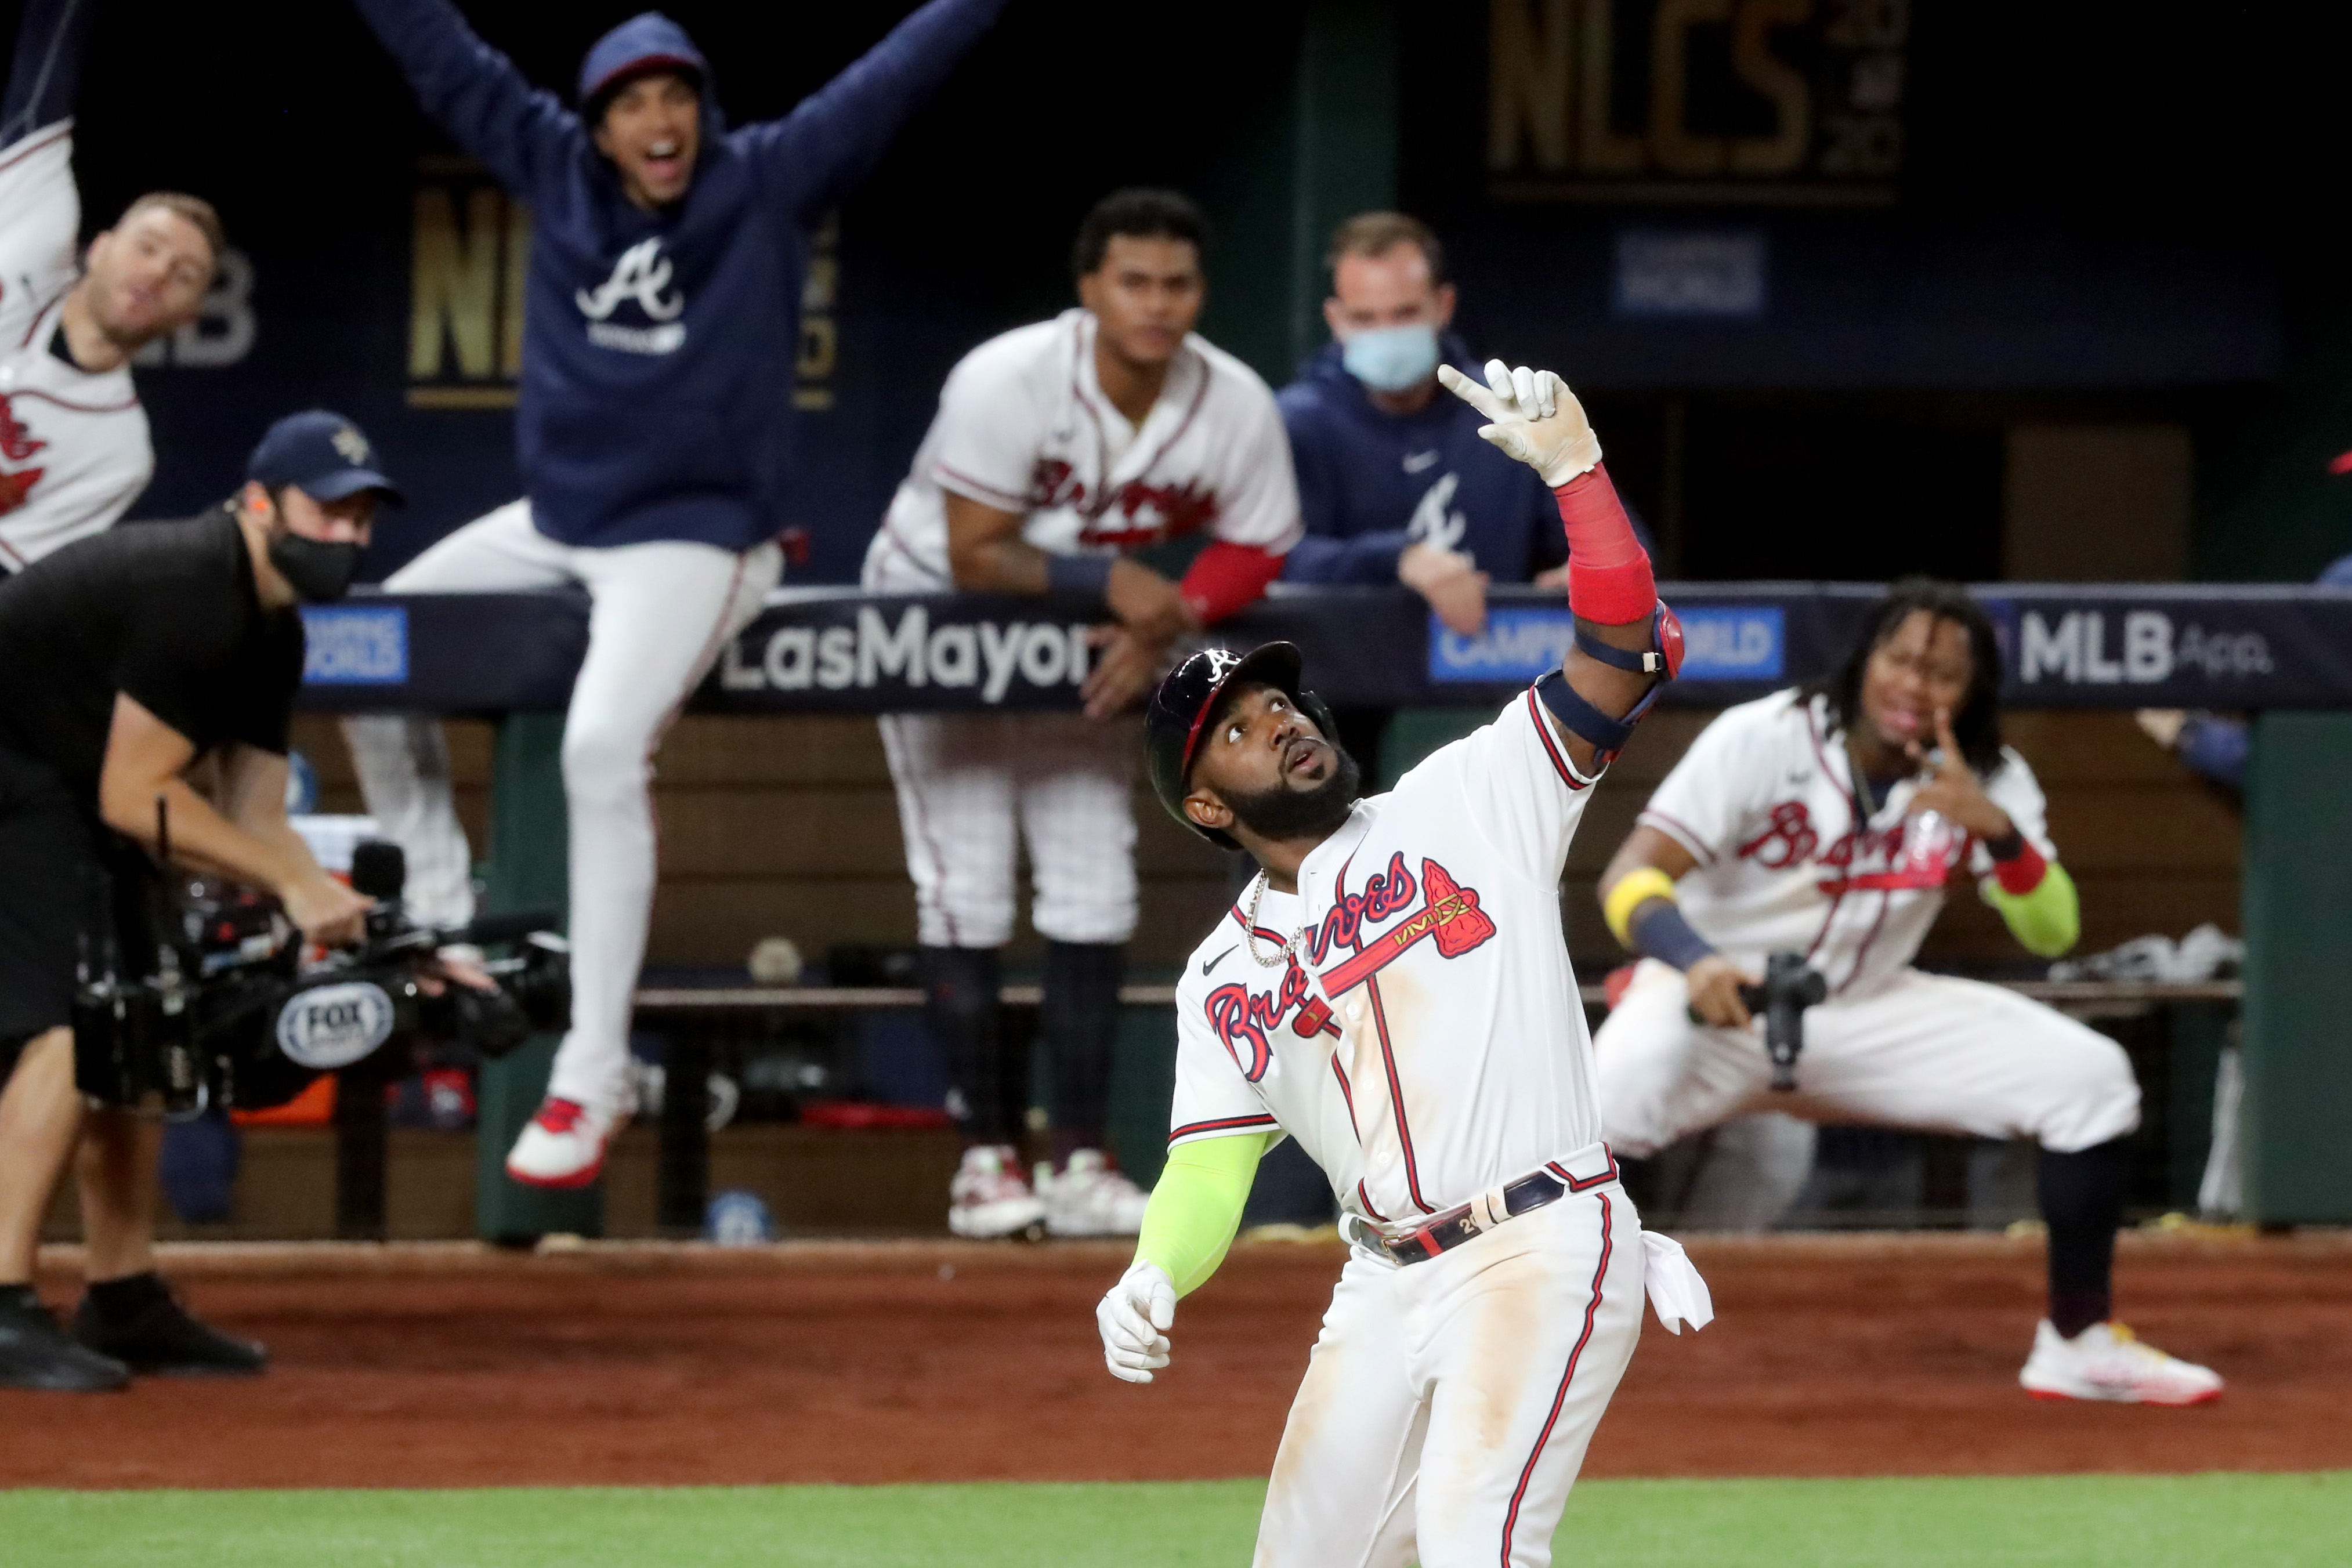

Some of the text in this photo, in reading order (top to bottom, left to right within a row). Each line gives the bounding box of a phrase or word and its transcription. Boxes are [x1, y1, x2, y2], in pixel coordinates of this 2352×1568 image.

[1487, 0, 1811, 172] NLCS
[718, 604, 1090, 703] LasMayor
[2020, 609, 2174, 685] MLB
[309, 999, 362, 1027] FOX
[1204, 850, 1417, 1083] Braves
